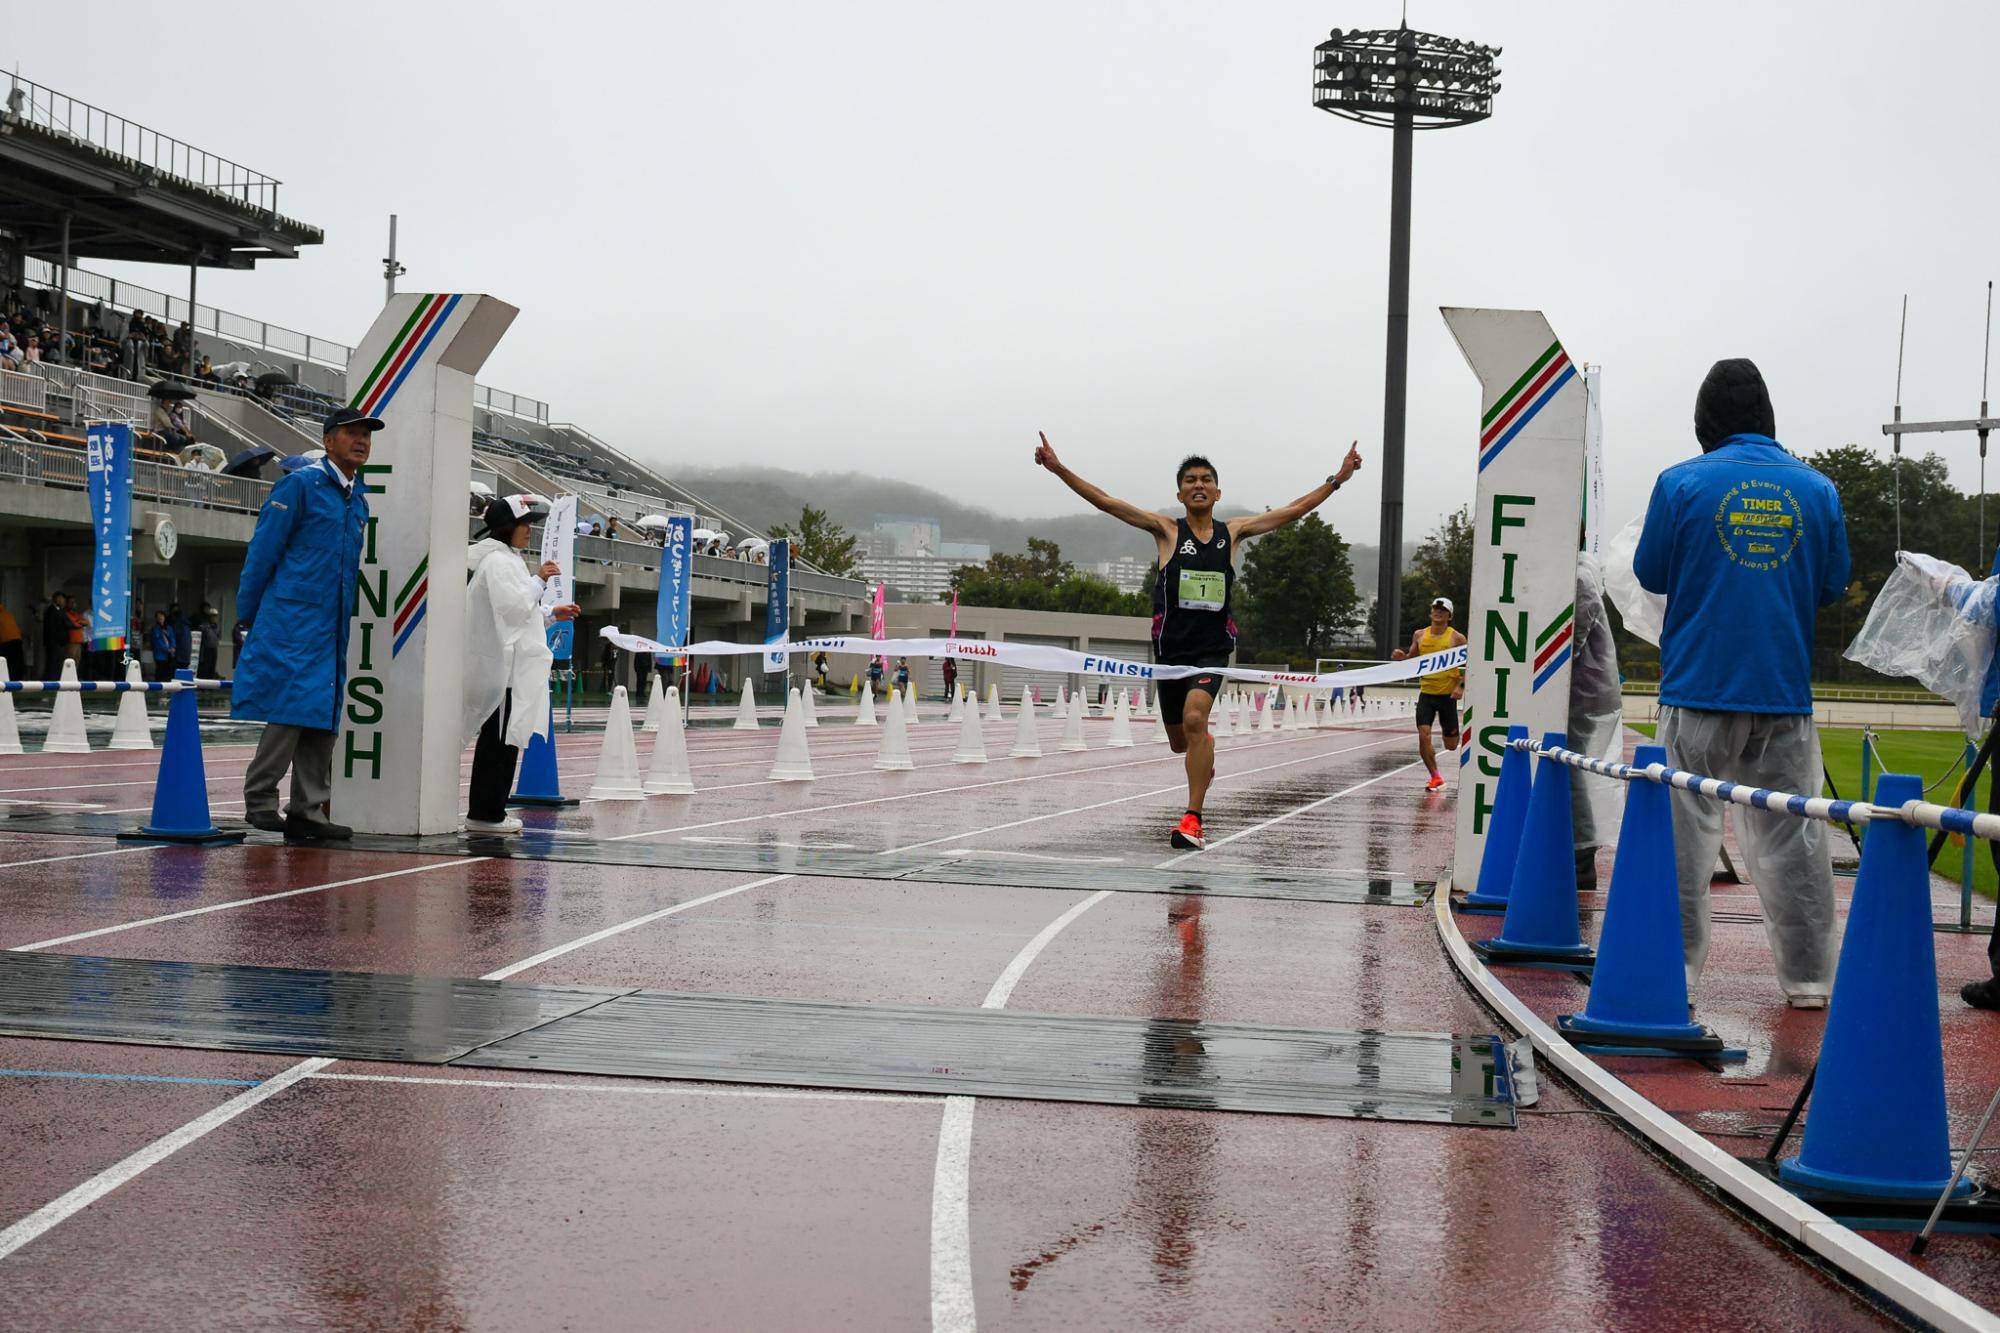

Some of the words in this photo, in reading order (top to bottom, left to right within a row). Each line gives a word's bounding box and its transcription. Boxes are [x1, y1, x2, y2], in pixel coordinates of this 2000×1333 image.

[1751, 480, 1781, 491] Event
[1741, 498, 1782, 511] TIMER
[1200, 584, 1206, 597] 1
[344, 465, 392, 779] FINISH
[946, 643, 997, 657] Finish
[1083, 657, 1153, 679] FINISH
